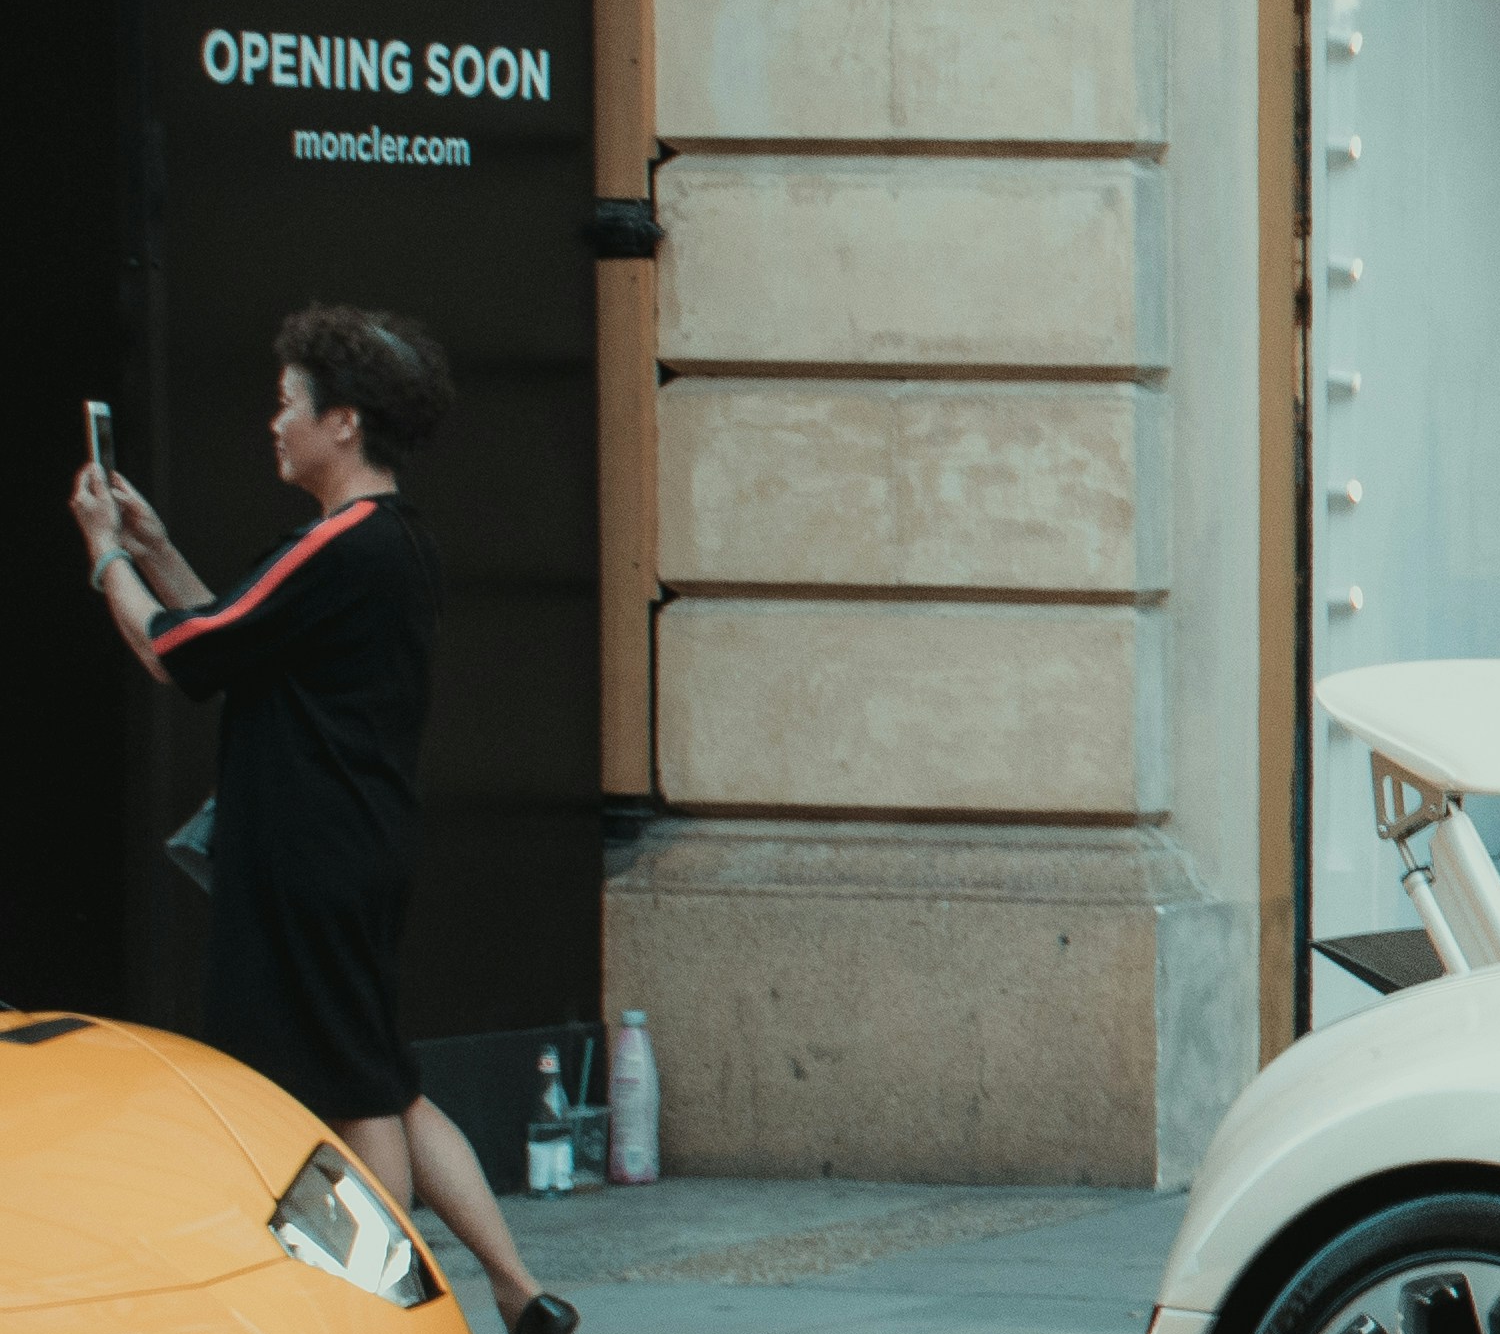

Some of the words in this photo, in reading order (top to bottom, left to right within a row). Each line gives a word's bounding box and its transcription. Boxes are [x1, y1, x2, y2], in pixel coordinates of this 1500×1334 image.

[203, 27, 414, 95] OPENING
[425, 41, 551, 102] SOON
[292, 124, 472, 167] moncler.com
